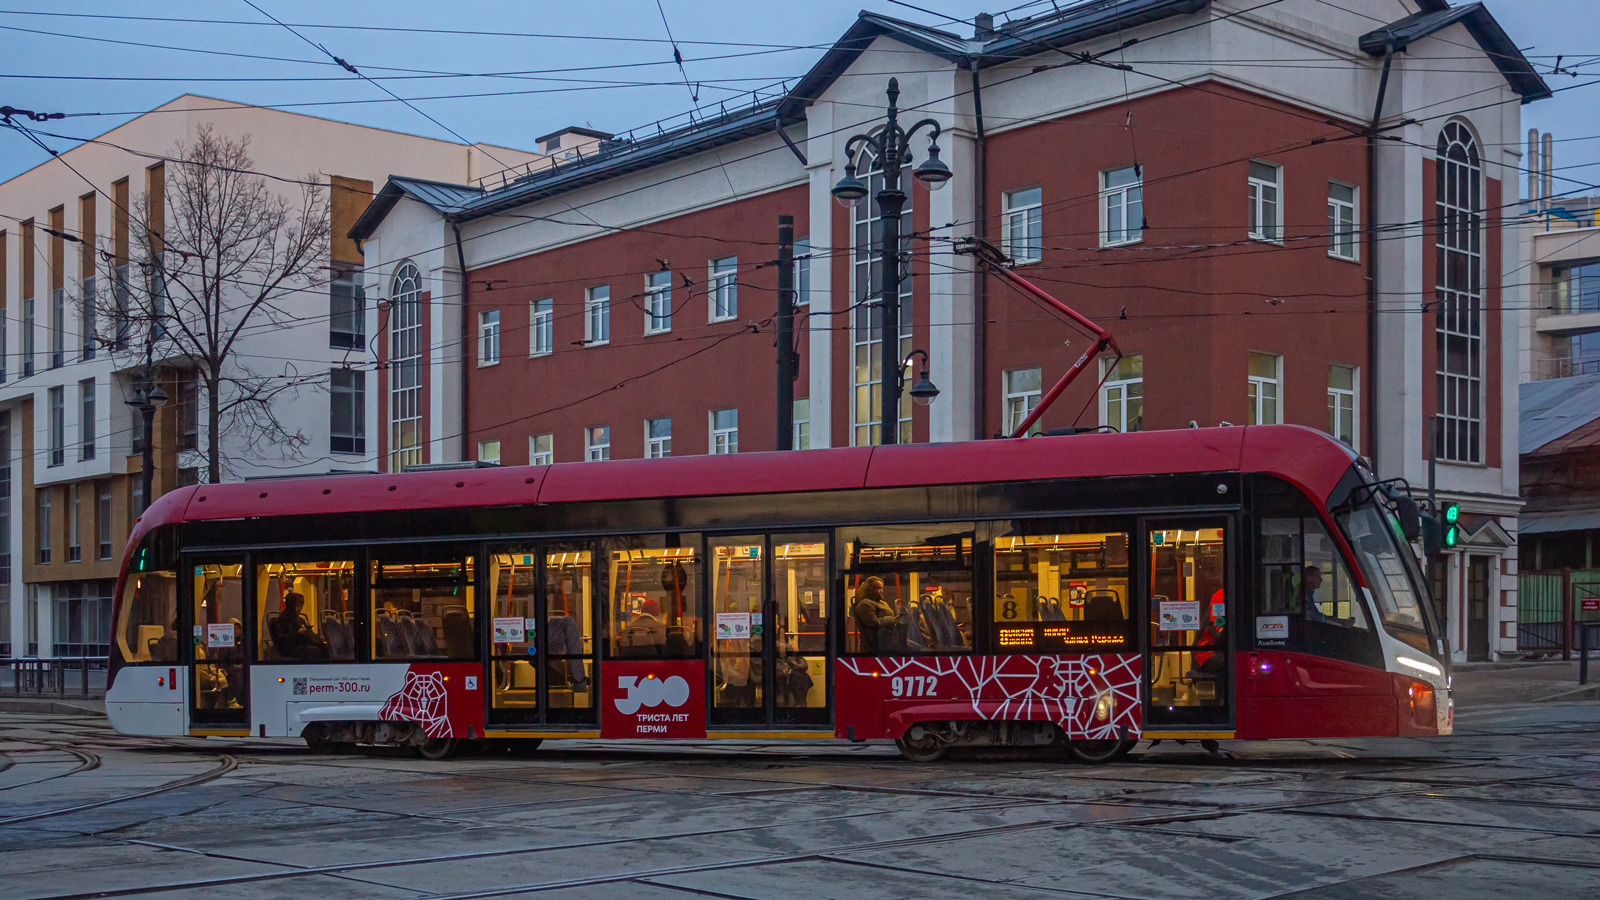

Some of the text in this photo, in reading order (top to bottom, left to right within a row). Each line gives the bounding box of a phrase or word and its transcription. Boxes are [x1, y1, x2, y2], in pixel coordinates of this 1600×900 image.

[1002, 600, 1018, 620] 8
[309, 682, 371, 695] perm-300.ru
[891, 675, 938, 697] 9772
[614, 675, 690, 715] 300
[636, 713, 690, 722] ТРИСТА ЛЕТ
[636, 725, 667, 733] ПЕРМИ
